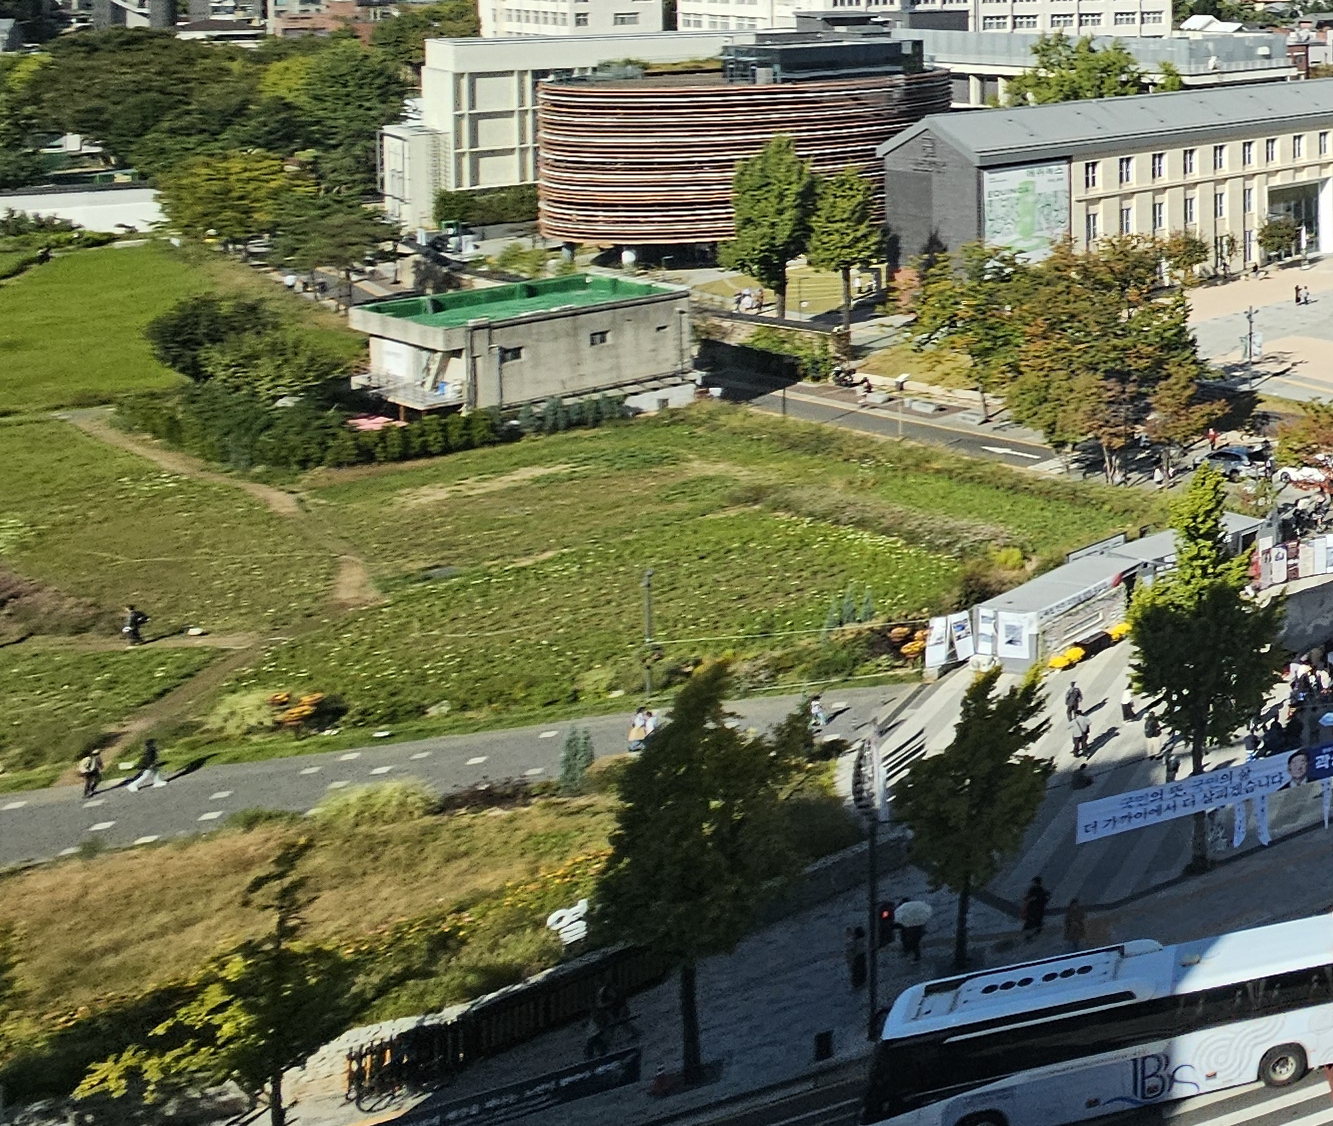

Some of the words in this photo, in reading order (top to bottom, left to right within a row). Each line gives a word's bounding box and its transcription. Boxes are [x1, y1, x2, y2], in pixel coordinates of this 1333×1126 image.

[1084, 820, 1098, 835] 더
[1102, 800, 1178, 830] 가까이에서
[1181, 795, 1196, 810] 더
[1202, 773, 1285, 805] 살피겠습니다
